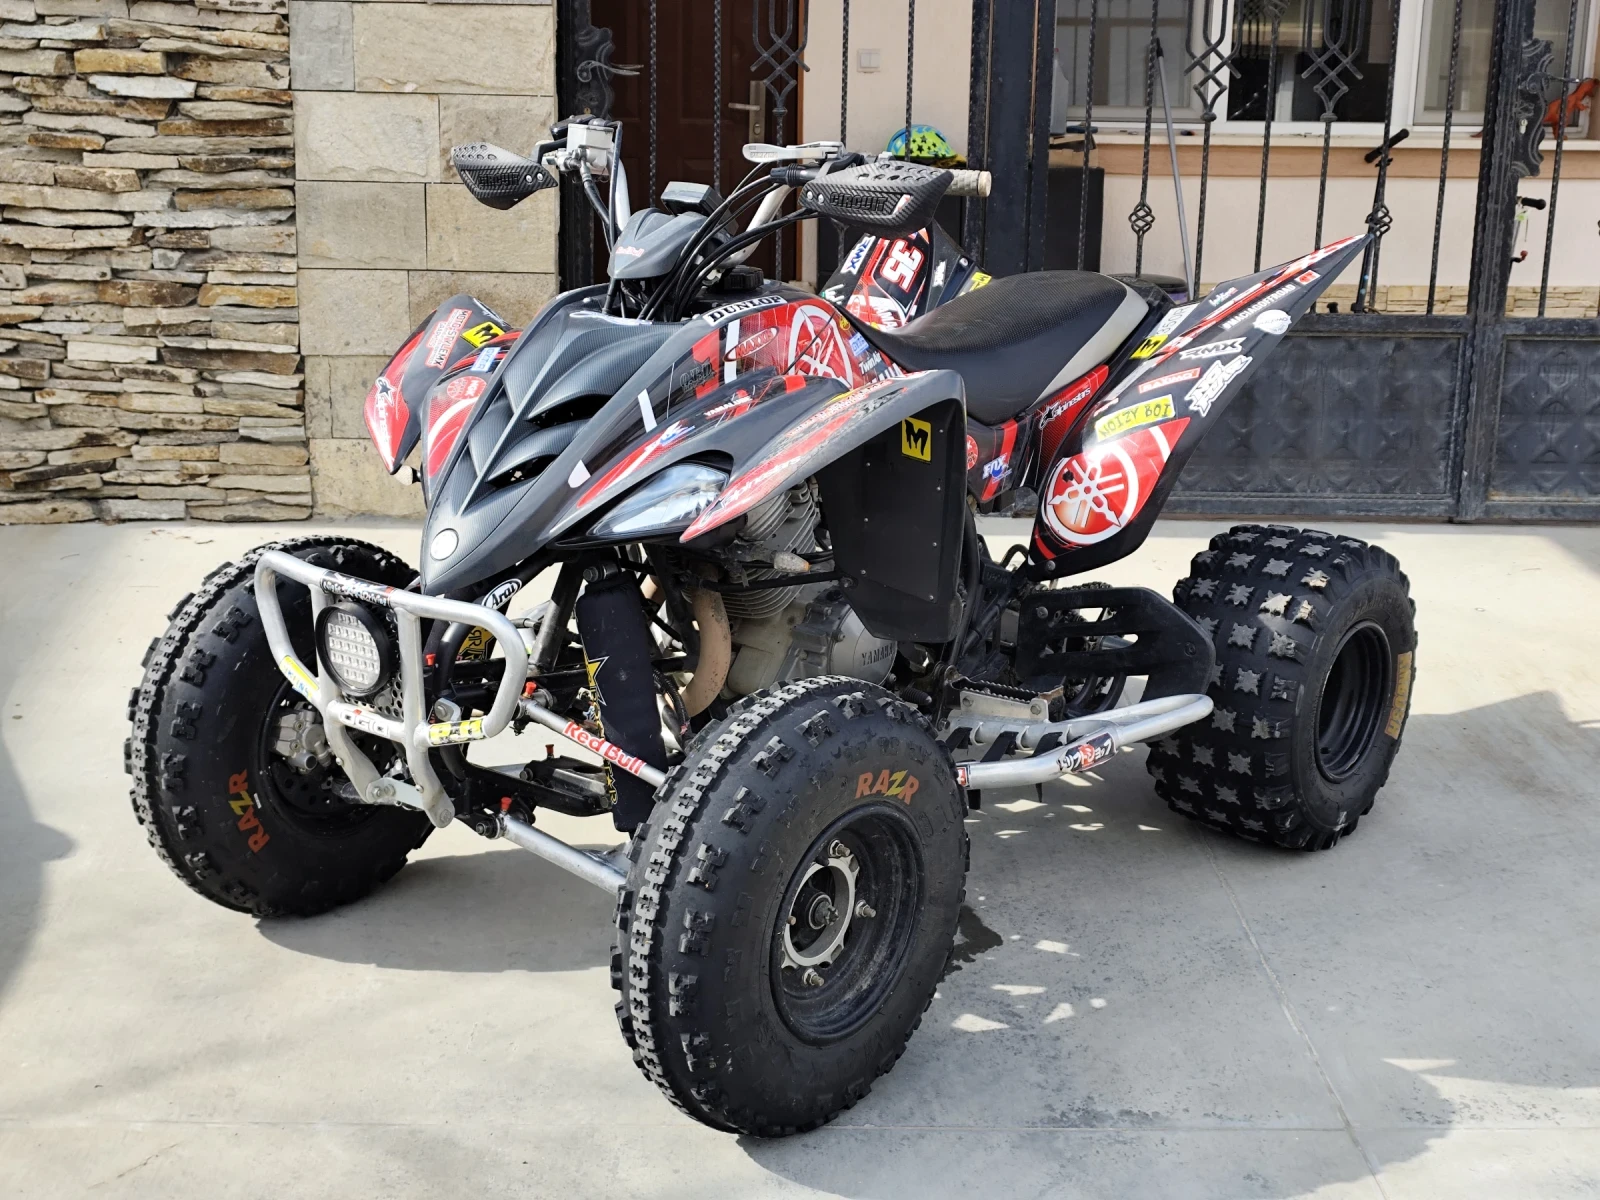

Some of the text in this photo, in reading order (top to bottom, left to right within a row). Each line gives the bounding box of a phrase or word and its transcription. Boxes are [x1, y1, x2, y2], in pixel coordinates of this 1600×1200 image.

[829, 192, 888, 212] CIRCUIT
[847, 237, 871, 270] RMX
[882, 240, 923, 292] 35
[708, 297, 781, 322] DUNLOP
[735, 328, 774, 359] MAXXIS
[1186, 341, 1238, 356] RMX
[1187, 361, 1224, 399] NO
[1051, 387, 1091, 419] alpinestars
[1098, 407, 1139, 437] NOIZY
[1144, 403, 1171, 418] BOI
[904, 419, 928, 456] M
[983, 453, 1008, 479] FOX
[492, 583, 516, 607] Arai
[562, 720, 646, 776] Red Bull
[855, 769, 919, 805] RAZR
[227, 768, 270, 853] RAZR
